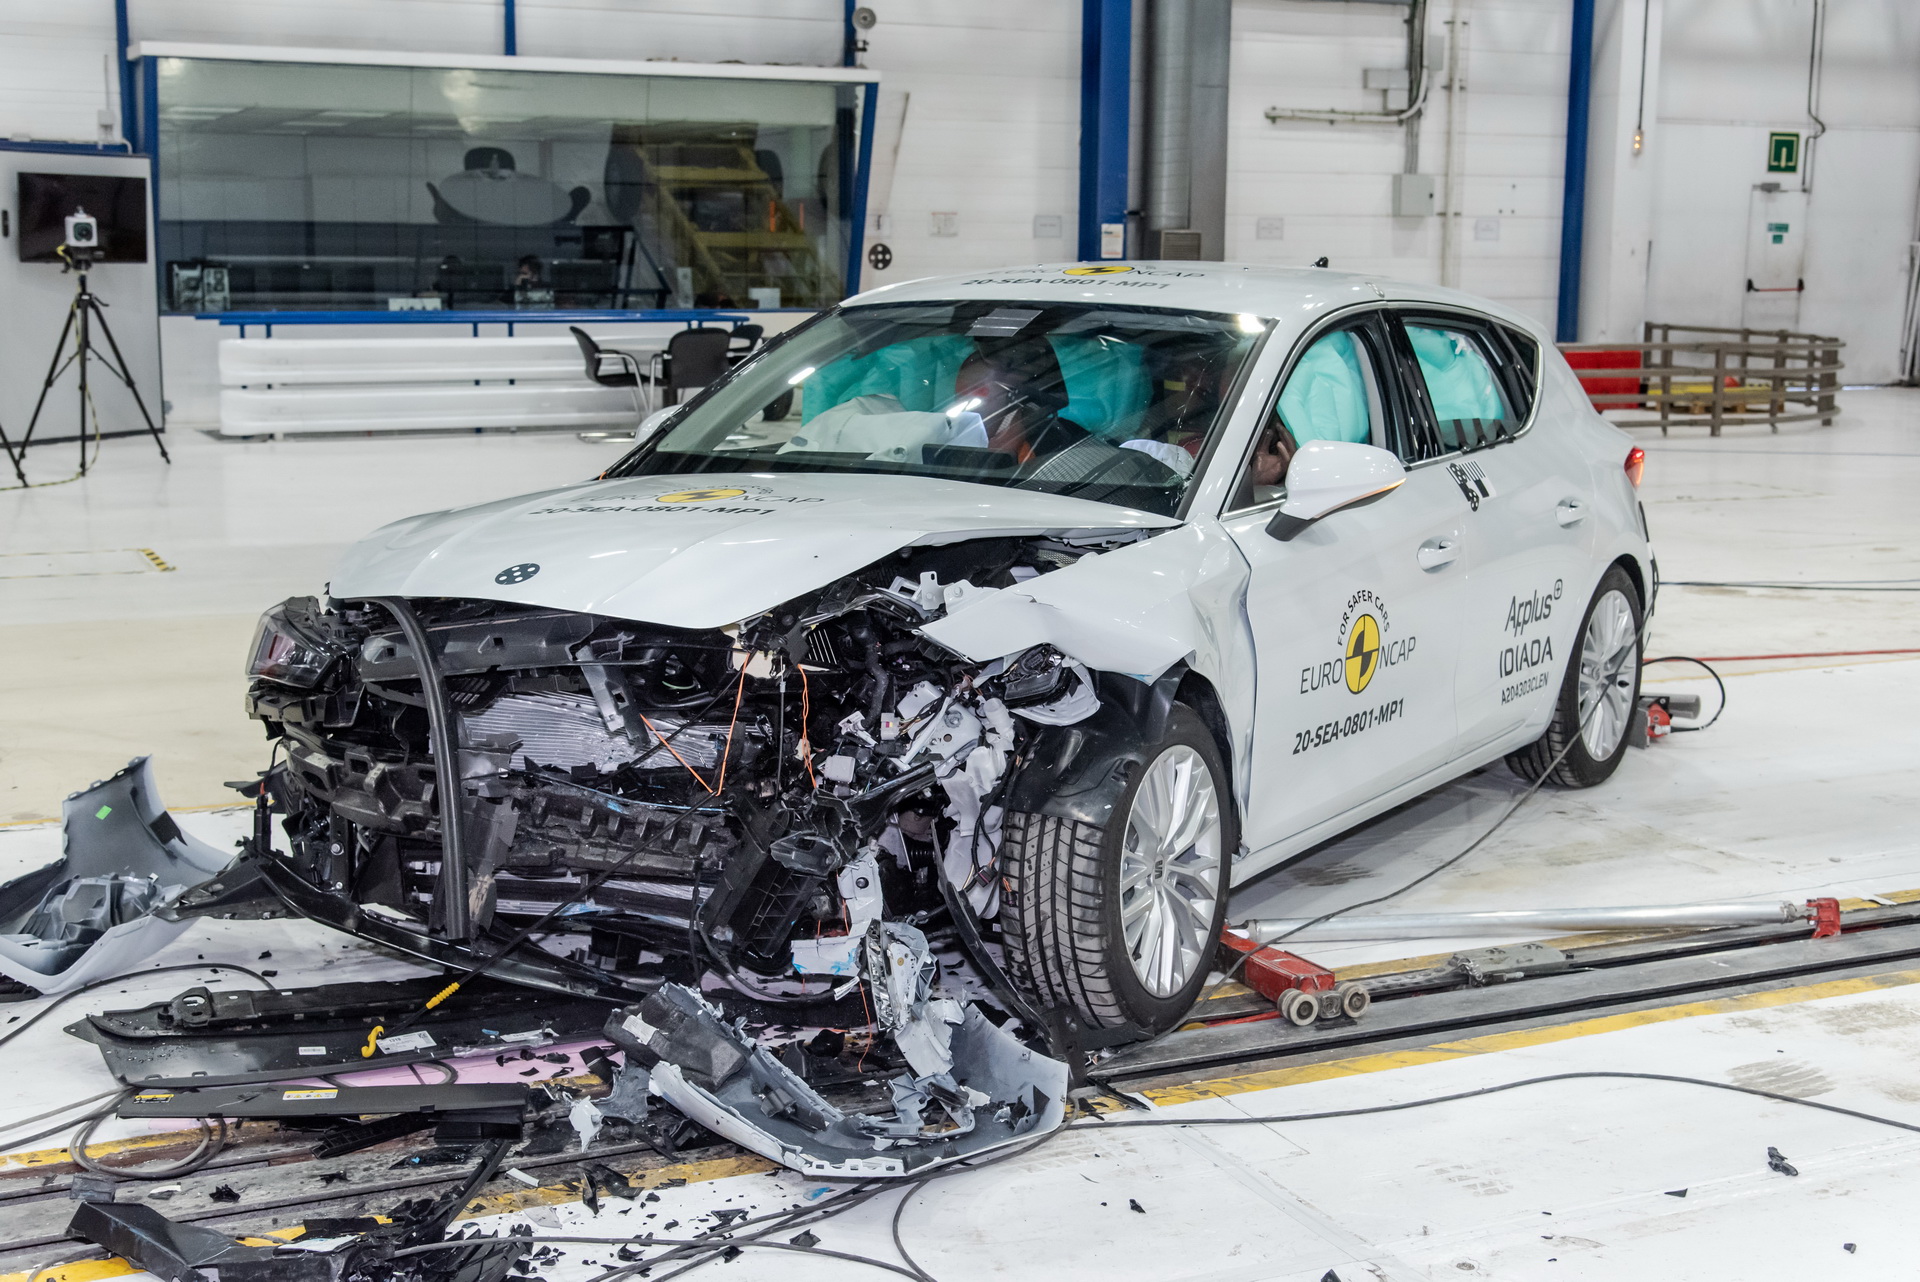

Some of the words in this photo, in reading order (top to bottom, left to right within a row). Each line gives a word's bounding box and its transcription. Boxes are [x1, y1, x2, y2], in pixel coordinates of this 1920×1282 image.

[961, 278, 1171, 290] 20-SEA-0801-MP1
[1127, 270, 1206, 278] NCAP
[528, 505, 777, 516] 20-SEA-0801-MP1
[729, 495, 826, 504] NCAP
[1337, 611, 1350, 646] FOR
[1347, 589, 1373, 614] SAFER
[1374, 596, 1391, 633] CARS
[1300, 658, 1344, 695] EURO
[1379, 636, 1417, 670] NCAP
[1500, 635, 1553, 678] IDIADA
[1292, 697, 1404, 756] 20-SEA-0801-MP1
